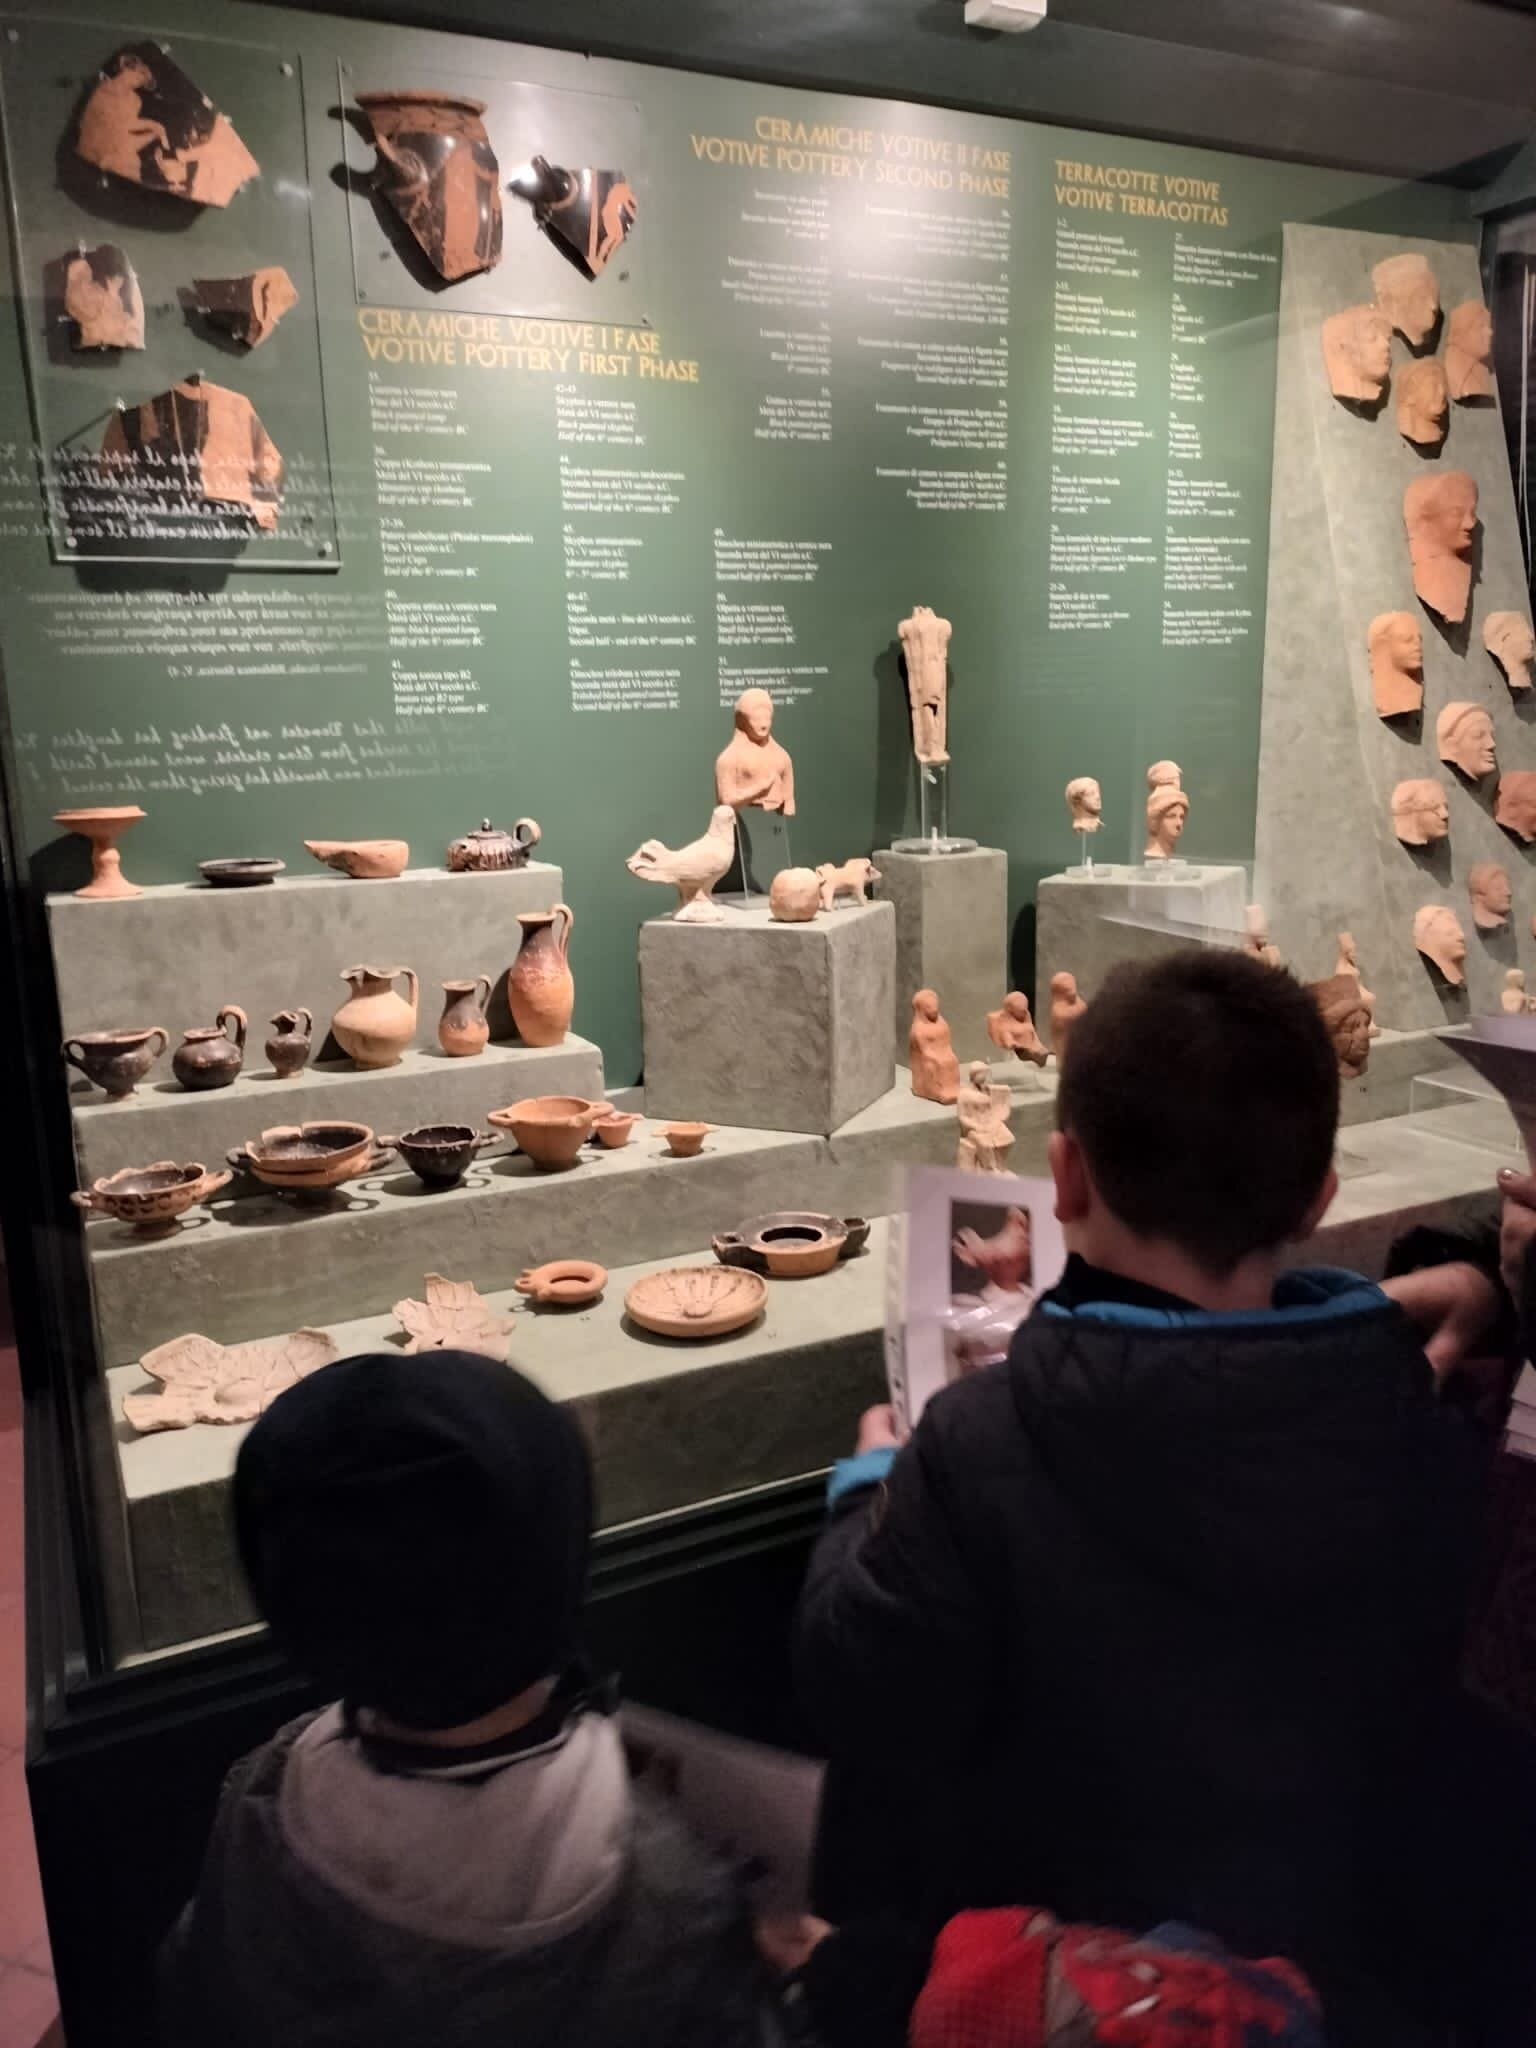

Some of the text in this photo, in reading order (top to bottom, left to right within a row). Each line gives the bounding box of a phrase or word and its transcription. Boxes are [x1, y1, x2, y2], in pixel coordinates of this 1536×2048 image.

[691, 134, 1010, 199] VOTIVE POTTERY SECOND PHASE
[755, 116, 1011, 171] CERAMICHE VOTIVE II FASE
[1056, 160, 1221, 201] TERRACOTTE VOTIVE
[1055, 185, 1229, 226] VOTIVE TERRACOTTAS
[358, 308, 661, 354] CERAMICHE VOTIVE I FASE
[362, 336, 699, 383] VOTIVE POTTERY FIRST PHASE
